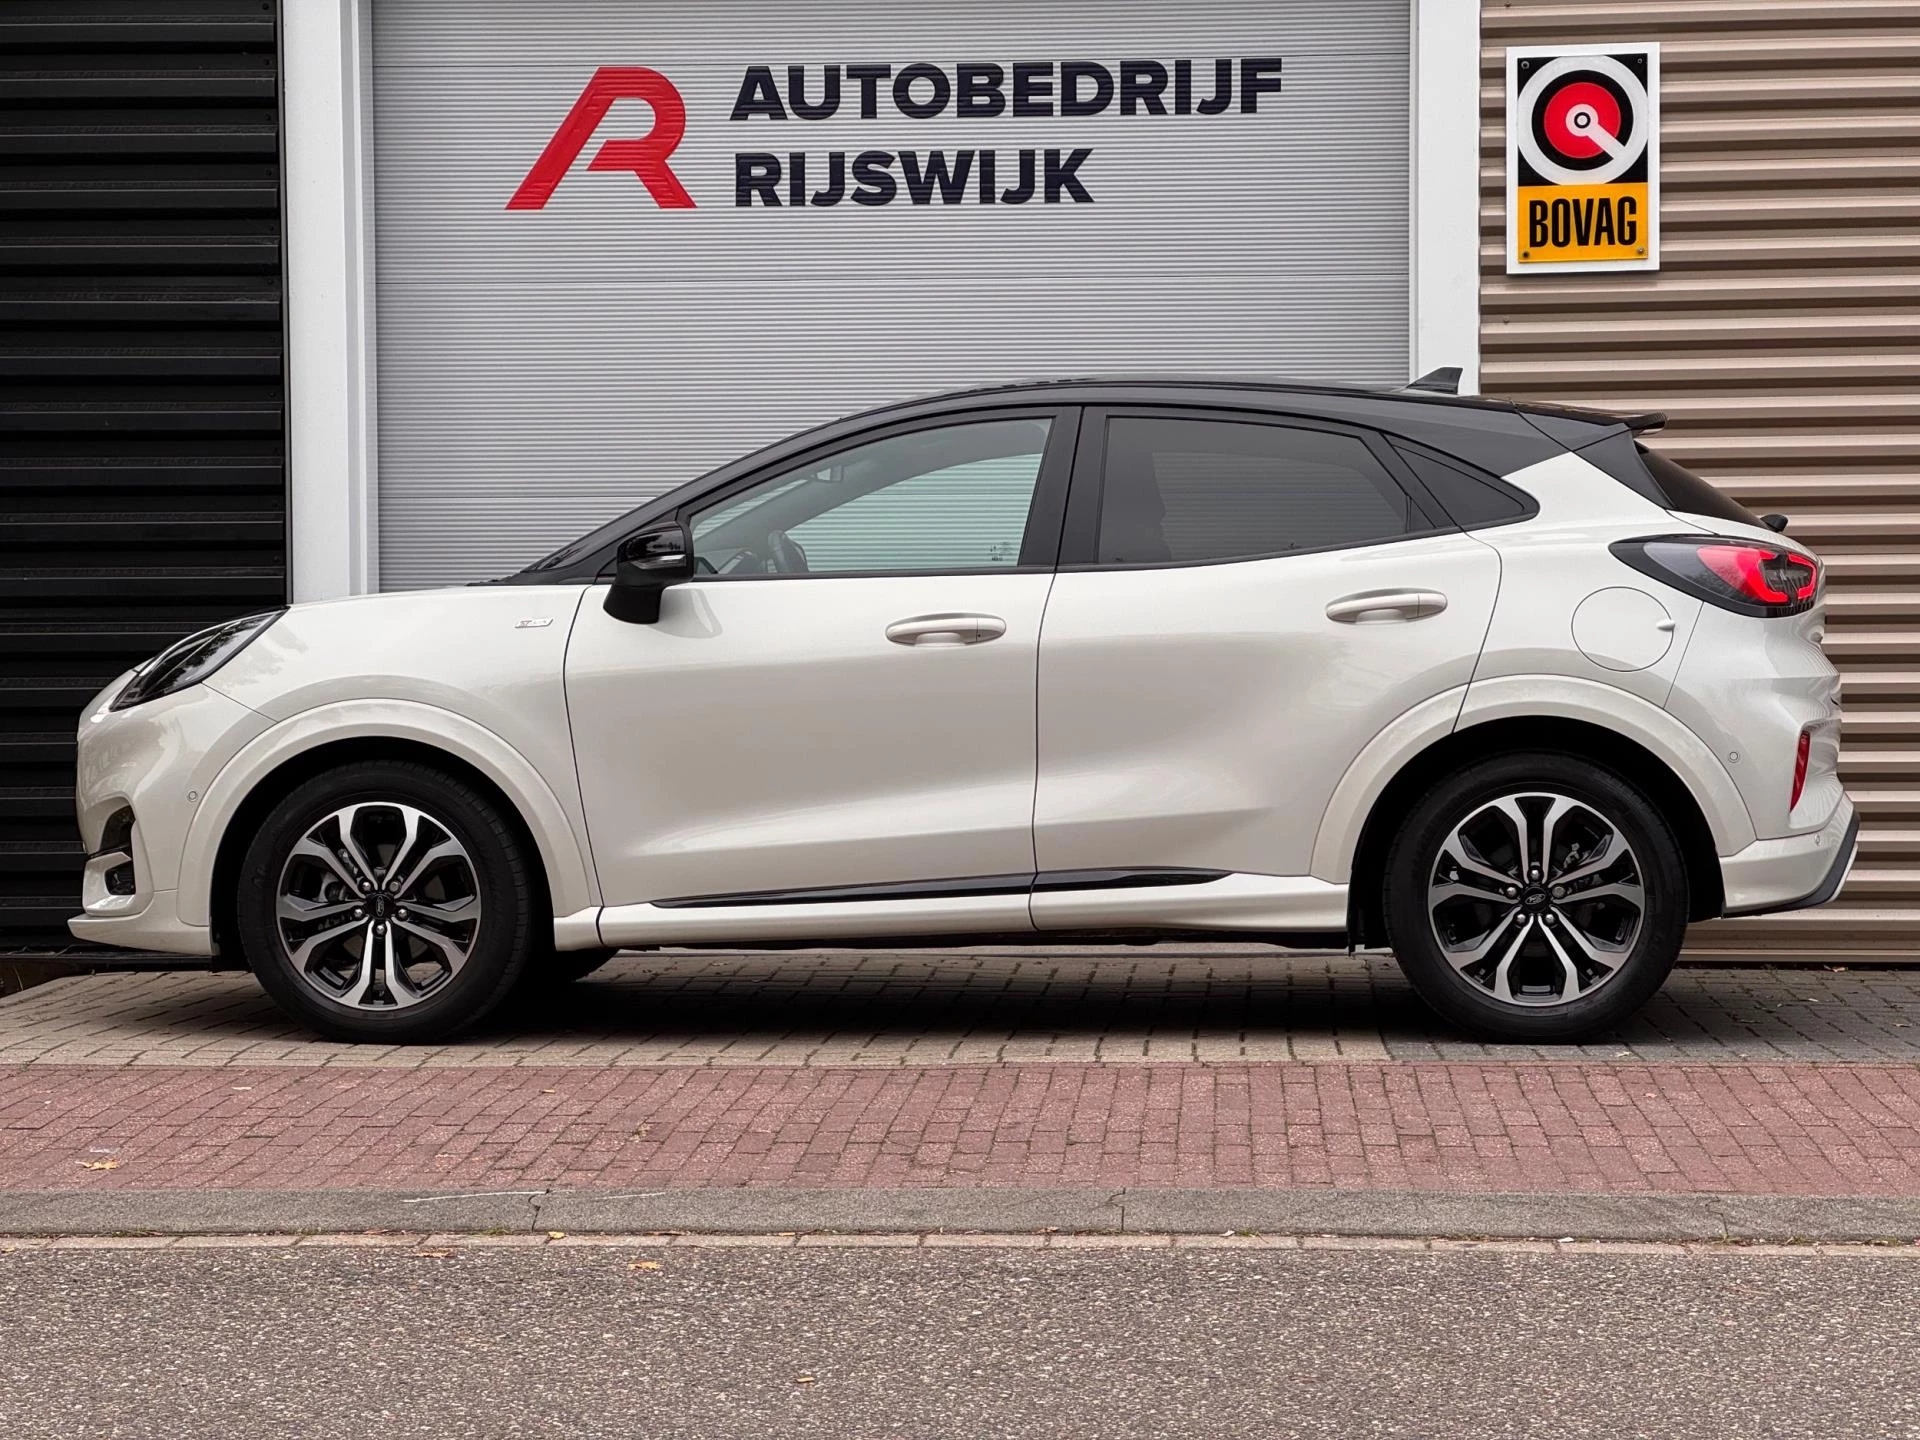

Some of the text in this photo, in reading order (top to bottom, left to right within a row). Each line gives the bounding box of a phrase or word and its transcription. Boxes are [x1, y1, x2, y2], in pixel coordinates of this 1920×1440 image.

[730, 58, 1282, 121] AUTOBEDRIJF
[736, 148, 1095, 208] RIJSWIJK
[1529, 196, 1637, 248] BOVAG
